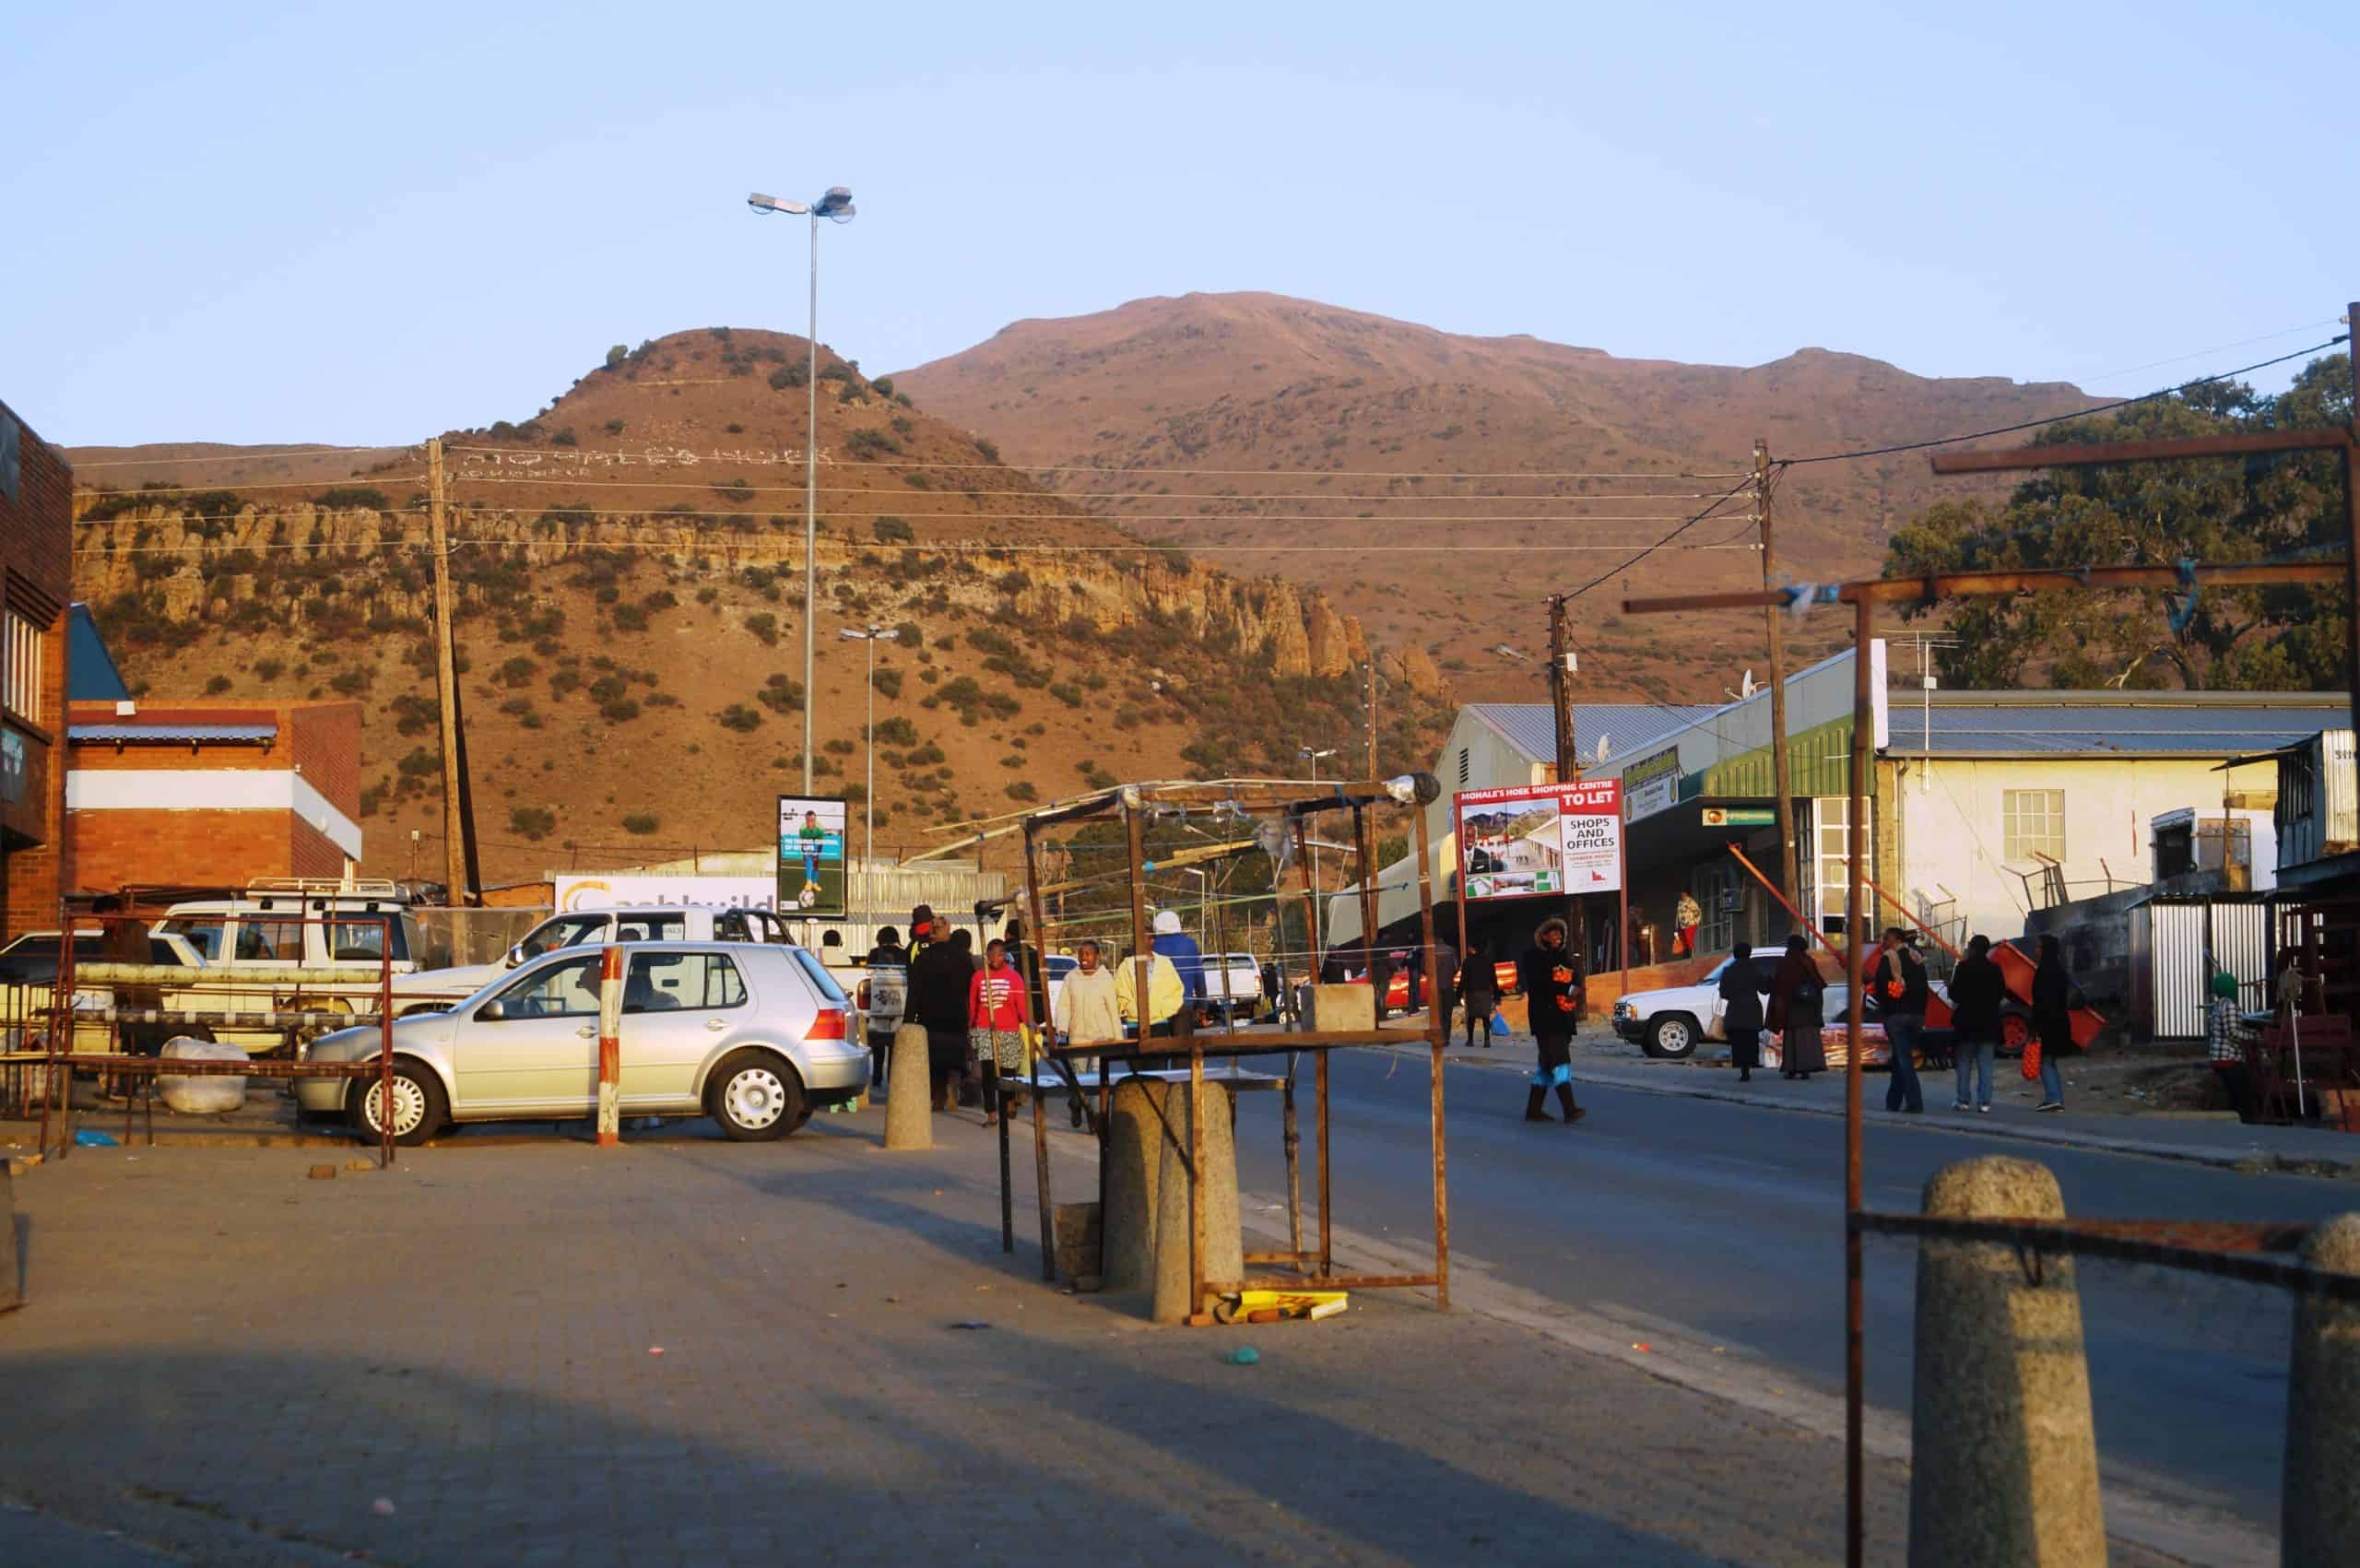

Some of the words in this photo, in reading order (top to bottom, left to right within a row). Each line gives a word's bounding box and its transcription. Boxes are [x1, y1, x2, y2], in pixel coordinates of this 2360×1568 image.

[1461, 789, 1504, 800] MOHALE'S
[1506, 786, 1530, 796] HOEK
[1532, 784, 1576, 794] SHOPPING
[1579, 780, 1612, 790] CENTRE
[1564, 794, 1585, 807] TO
[1587, 791, 1615, 805] LET
[1570, 818, 1610, 830] SHOPS
[1577, 828, 1604, 839] AND
[1567, 837, 1614, 849] OFFICES
